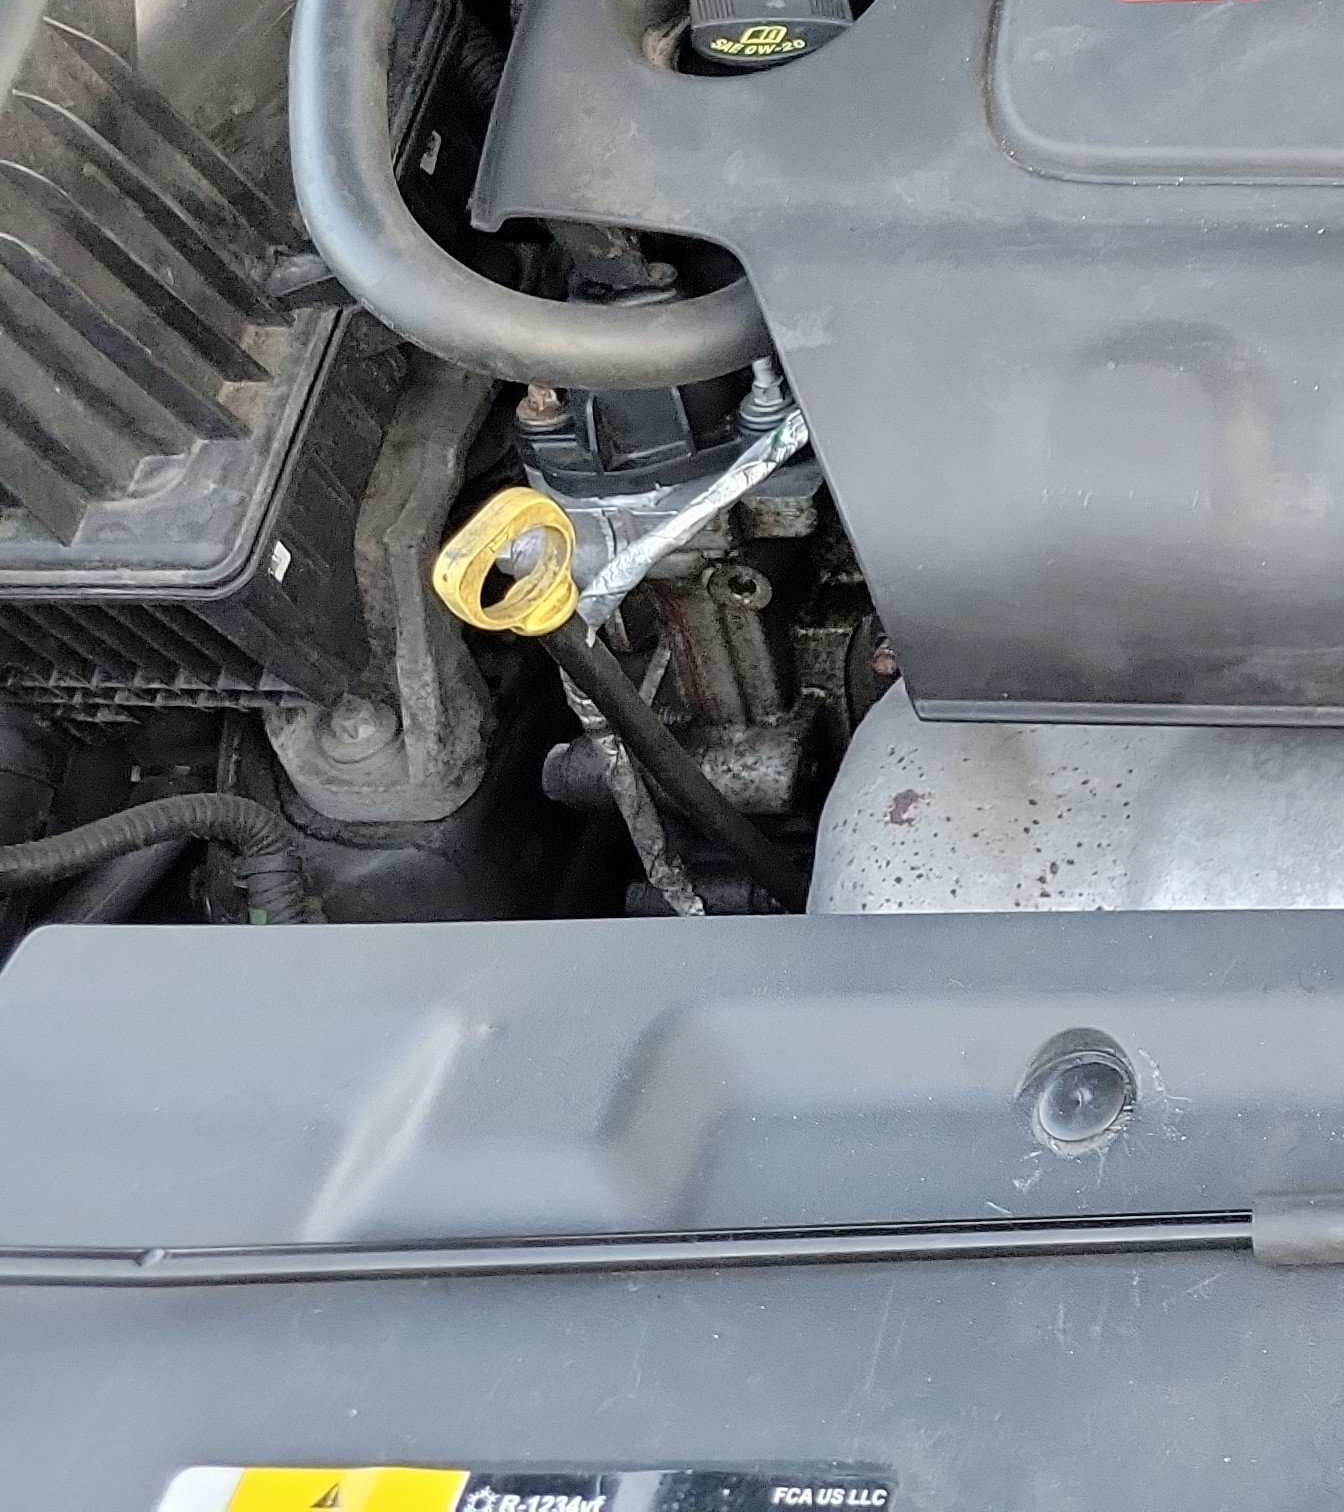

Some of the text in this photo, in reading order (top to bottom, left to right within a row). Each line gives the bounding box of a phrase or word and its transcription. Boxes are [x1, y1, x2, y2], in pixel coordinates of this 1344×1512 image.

[710, 38, 806, 55] SAE 0W-20
[772, 1486, 813, 1505] FCA
[817, 1488, 846, 1505] US
[847, 1488, 888, 1506] LLC
